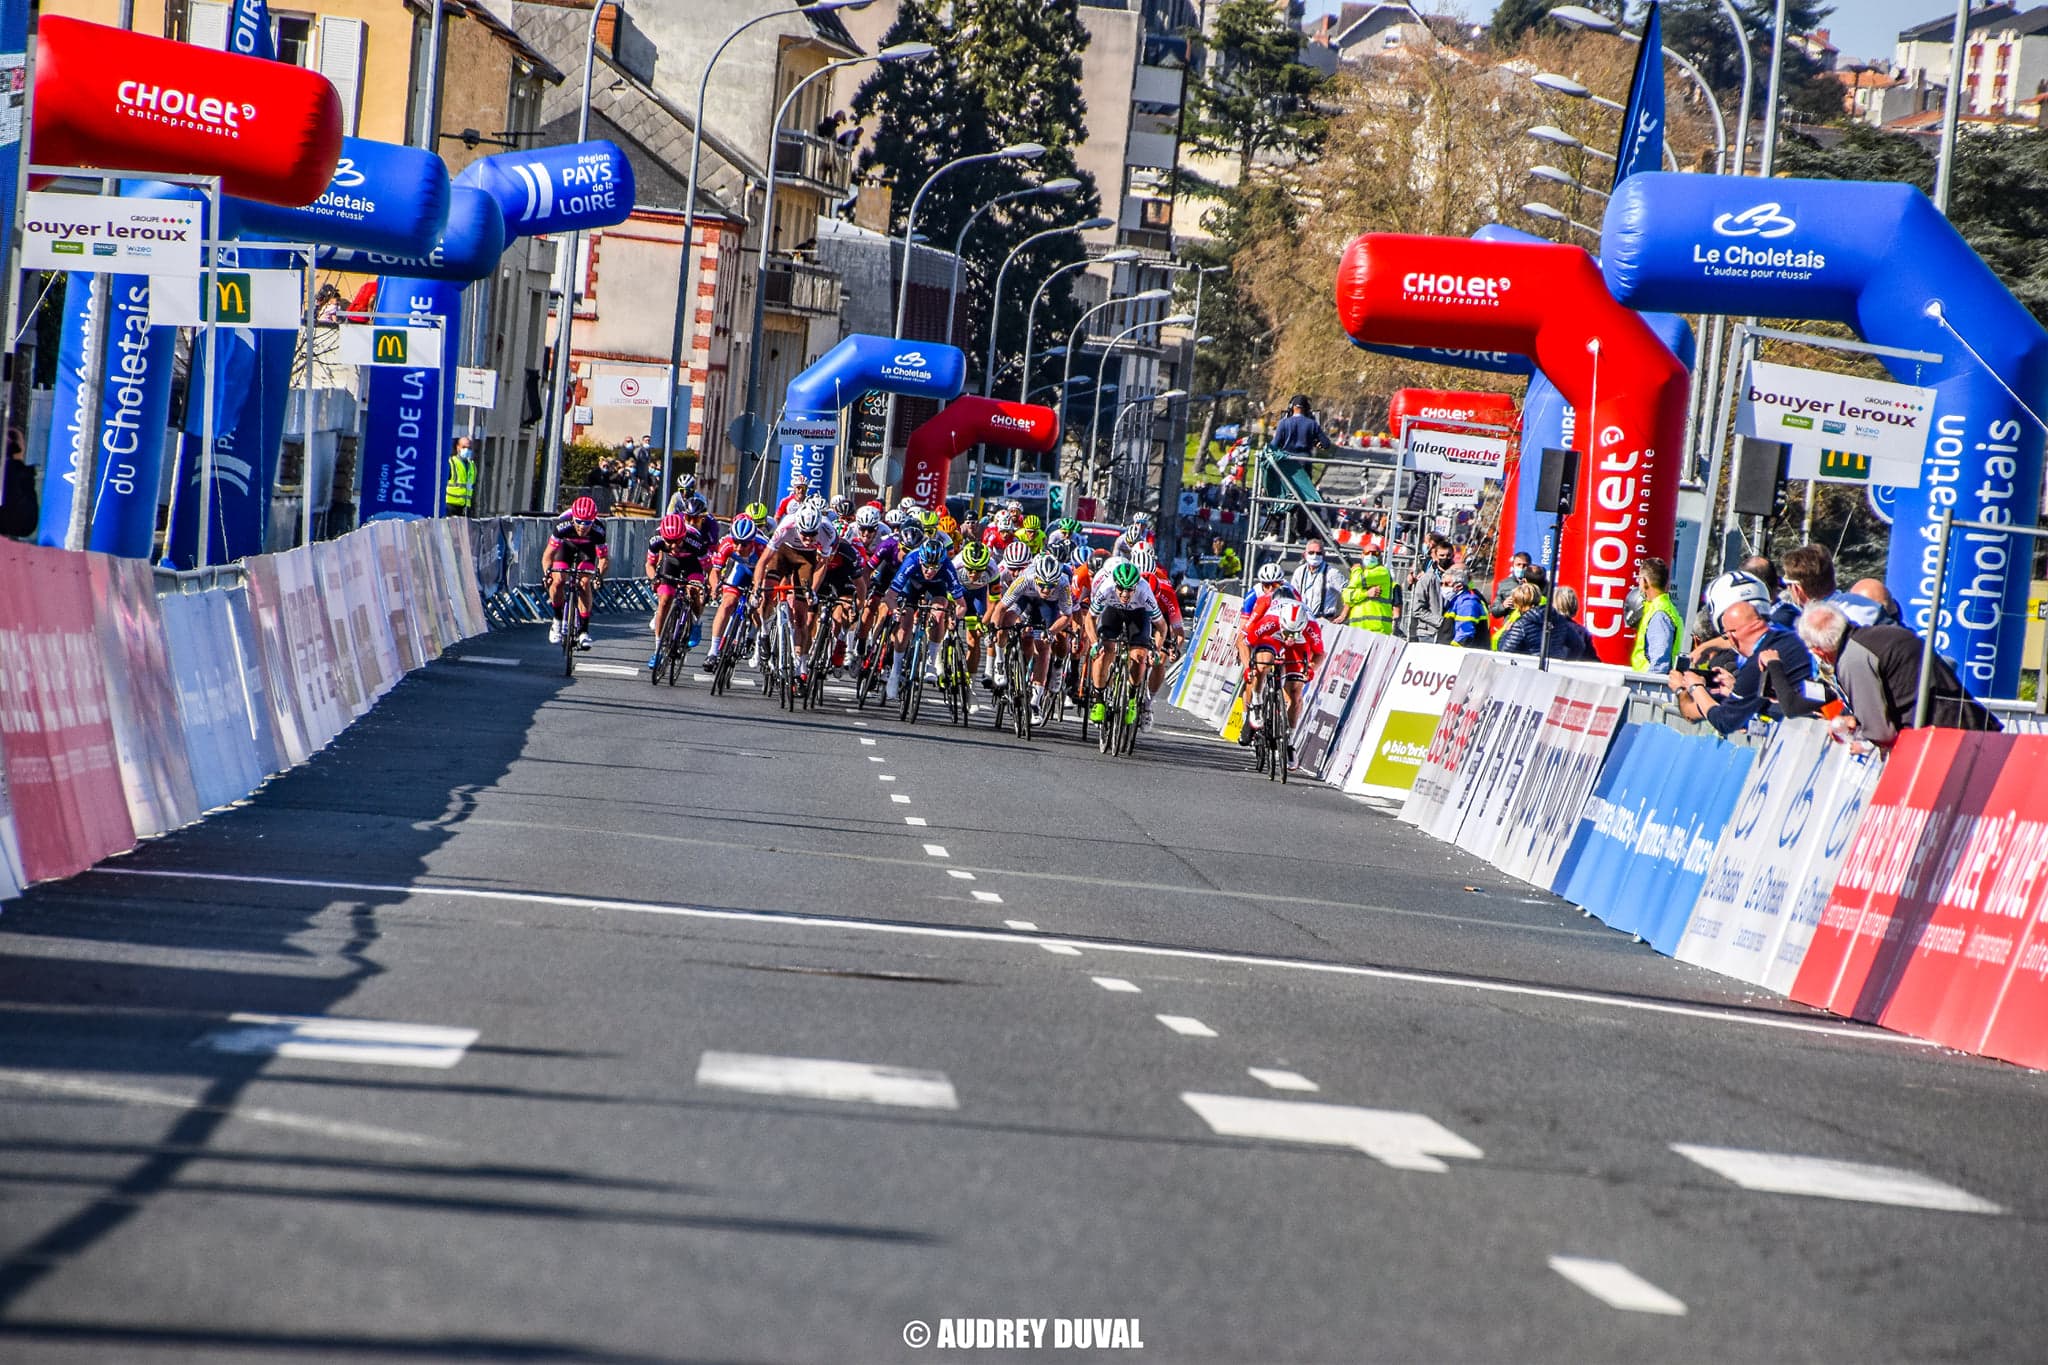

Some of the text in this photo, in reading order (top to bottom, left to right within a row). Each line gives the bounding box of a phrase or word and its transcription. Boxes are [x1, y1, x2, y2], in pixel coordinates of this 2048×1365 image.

[115, 103, 240, 139] l'entreprenante
[577, 153, 610, 165] Région
[562, 162, 612, 186] PAYS
[592, 184, 603, 192] de
[559, 191, 616, 215] LOIRE
[24, 220, 187, 242] ouyer leroux
[130, 215, 159, 223] GROUPE
[1693, 244, 1825, 269] Le Choletais
[1704, 265, 1812, 280] L'audace pour réussir
[1402, 292, 1500, 307] l'entreprenante
[881, 364, 891, 374] Le
[1749, 385, 1917, 427] bouyer leroux
[392, 370, 426, 506] PAYS DE LA
[1411, 441, 1501, 462] Intermarché
[109, 463, 136, 495] du
[377, 463, 389, 502] Région
[1909, 414, 1966, 651] gglomération
[1541, 534, 1552, 565] Région
[1956, 419, 2021, 681] du Choletais
[1401, 662, 1458, 695] bouye
